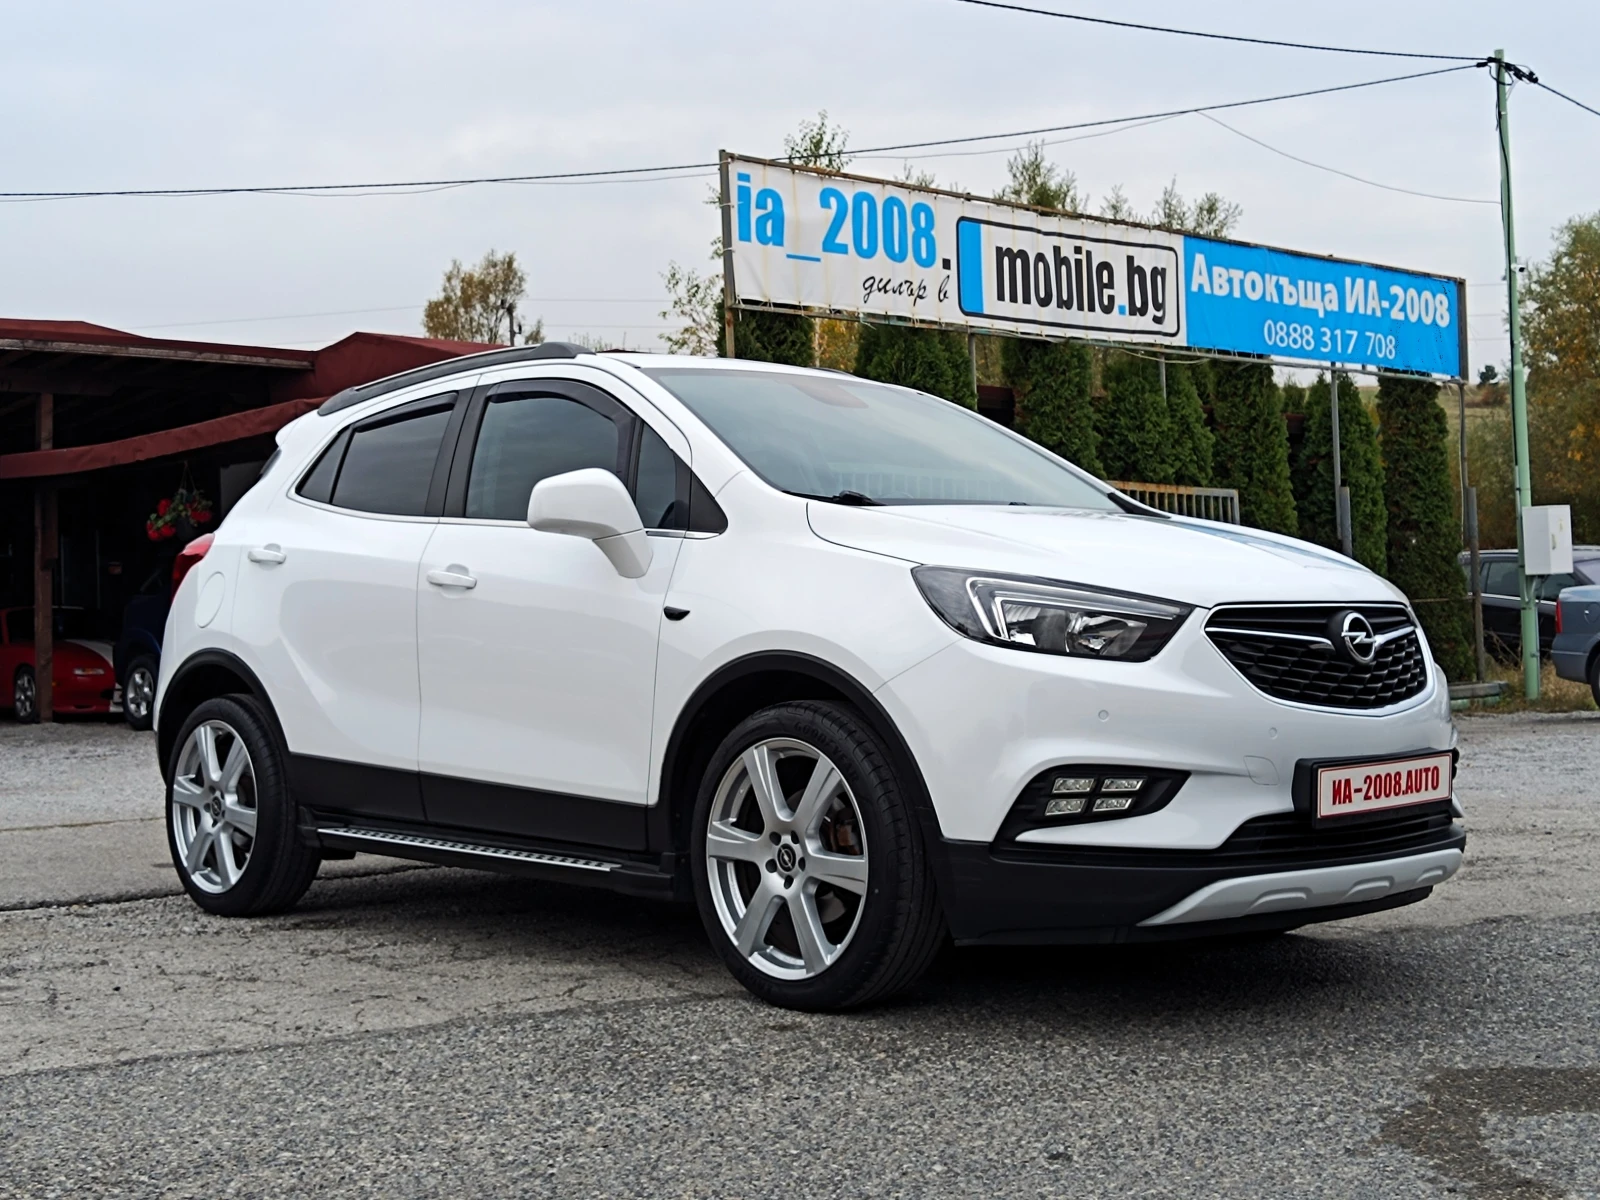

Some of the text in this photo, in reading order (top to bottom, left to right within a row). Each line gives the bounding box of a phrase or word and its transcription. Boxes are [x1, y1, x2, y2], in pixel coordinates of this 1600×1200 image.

[862, 276, 927, 307] дилър
[996, 246, 1167, 325] mobile.bg
[1191, 253, 1451, 328] Автокъща ИА-2008
[1263, 319, 1396, 360] 0888 317 708
